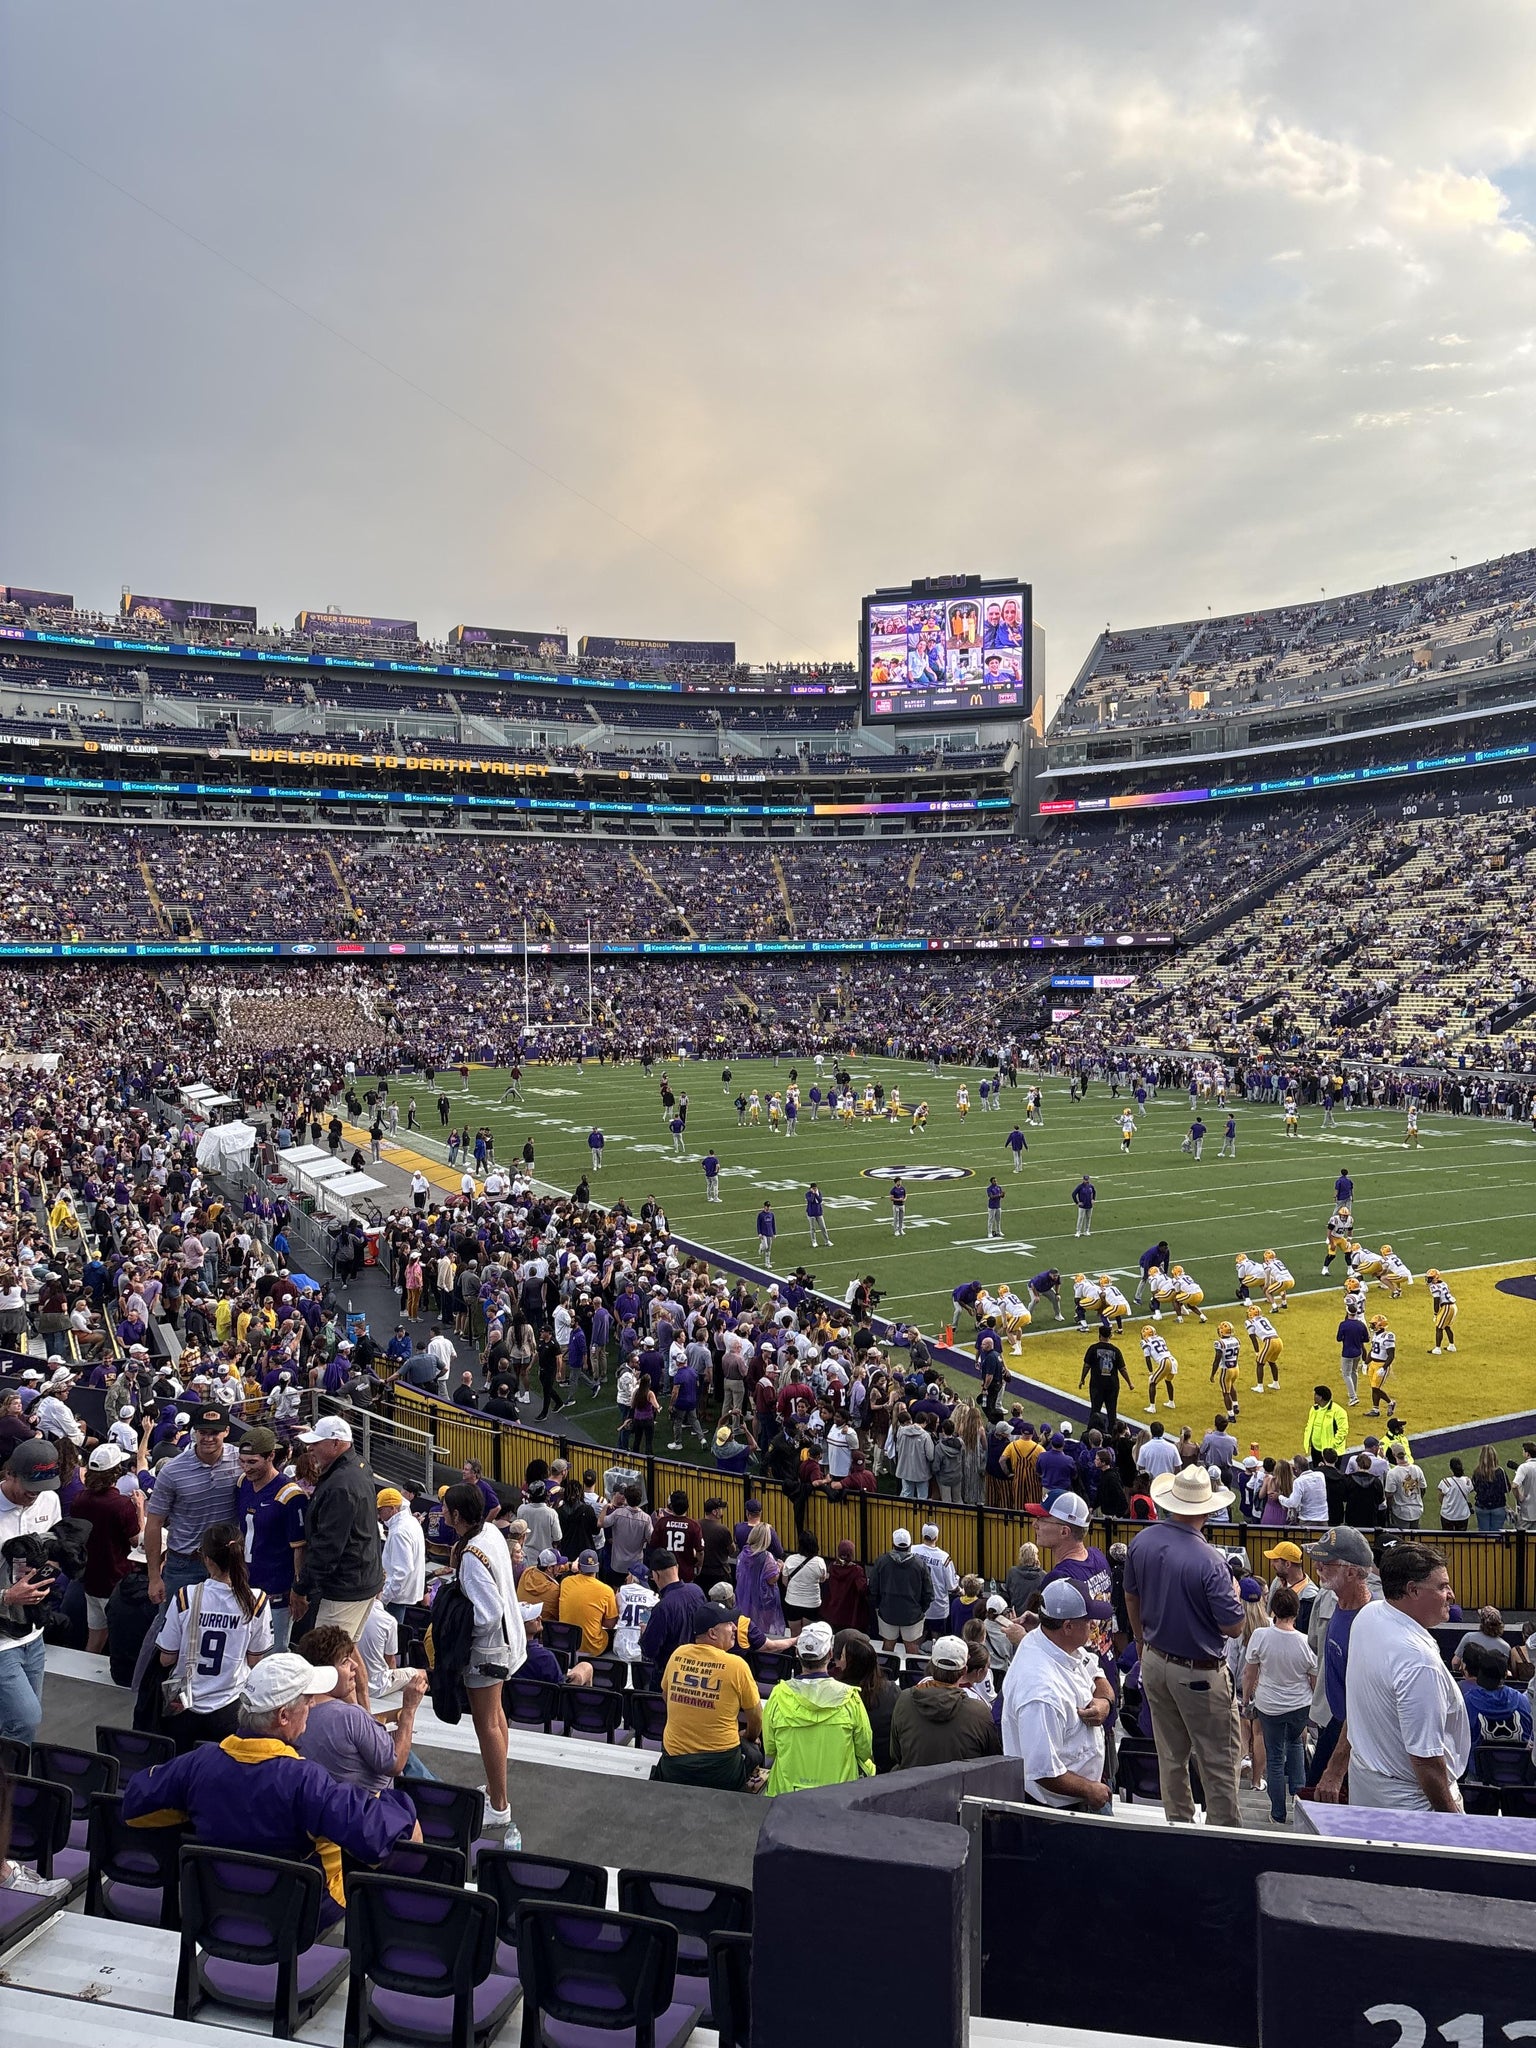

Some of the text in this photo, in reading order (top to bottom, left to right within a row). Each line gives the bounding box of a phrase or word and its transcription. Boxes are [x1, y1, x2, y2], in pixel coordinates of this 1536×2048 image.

[925, 574, 967, 591] LSU
[316, 614, 372, 625] TIGER STADIUM
[620, 640, 669, 649] TIGER STADIUM
[101, 743, 158, 754] TOMMY CASANOVA
[1483, 745, 1529, 760] KeeslerFederal
[250, 748, 549, 777] WELCOME TO DEATH VALLEY
[1424, 756, 1466, 767] KeeslerFederal
[1369, 764, 1409, 776] KeeslerFederal
[712, 774, 735, 782] CHARLES
[1319, 772, 1356, 783] KeeslerFederal
[53, 779, 104, 788] KeeslerFederal
[131, 783, 179, 792] KeeslerFederal
[1267, 779, 1305, 789] KeeslerFederal
[277, 789, 321, 797] KeeslerFederal
[1217, 785, 1254, 795] KeeslerFederal
[1497, 794, 1514, 805] 101
[1402, 805, 1418, 816] 100
[1251, 822, 1266, 831] 423
[971, 839, 985, 847] 421
[72, 946, 128, 954] KeeslerFederal
[220, 945, 274, 953] KeeslerFederal
[762, 943, 806, 951] KeeslerFederal
[878, 941, 921, 949] KeeslerFederal
[1259, 1319, 1272, 1331] 8
[34, 1514, 49, 1524] LSU
[666, 1520, 689, 1529] AGGIES
[244, 1513, 255, 1563] 1
[666, 1530, 686, 1552] 12
[625, 1594, 647, 1604] WEEKS
[197, 1630, 227, 1677] 9
[683, 1658, 696, 1666] TWO
[696, 1660, 726, 1670] FAVORITE
[680, 1664, 713, 1676] TEAMS ARE
[672, 1671, 722, 1692] LSU
[985, 1680, 991, 1693] 9
[676, 1686, 720, 1700] WHOEVER PLAYS
[1362, 2003, 1536, 2048] 21
